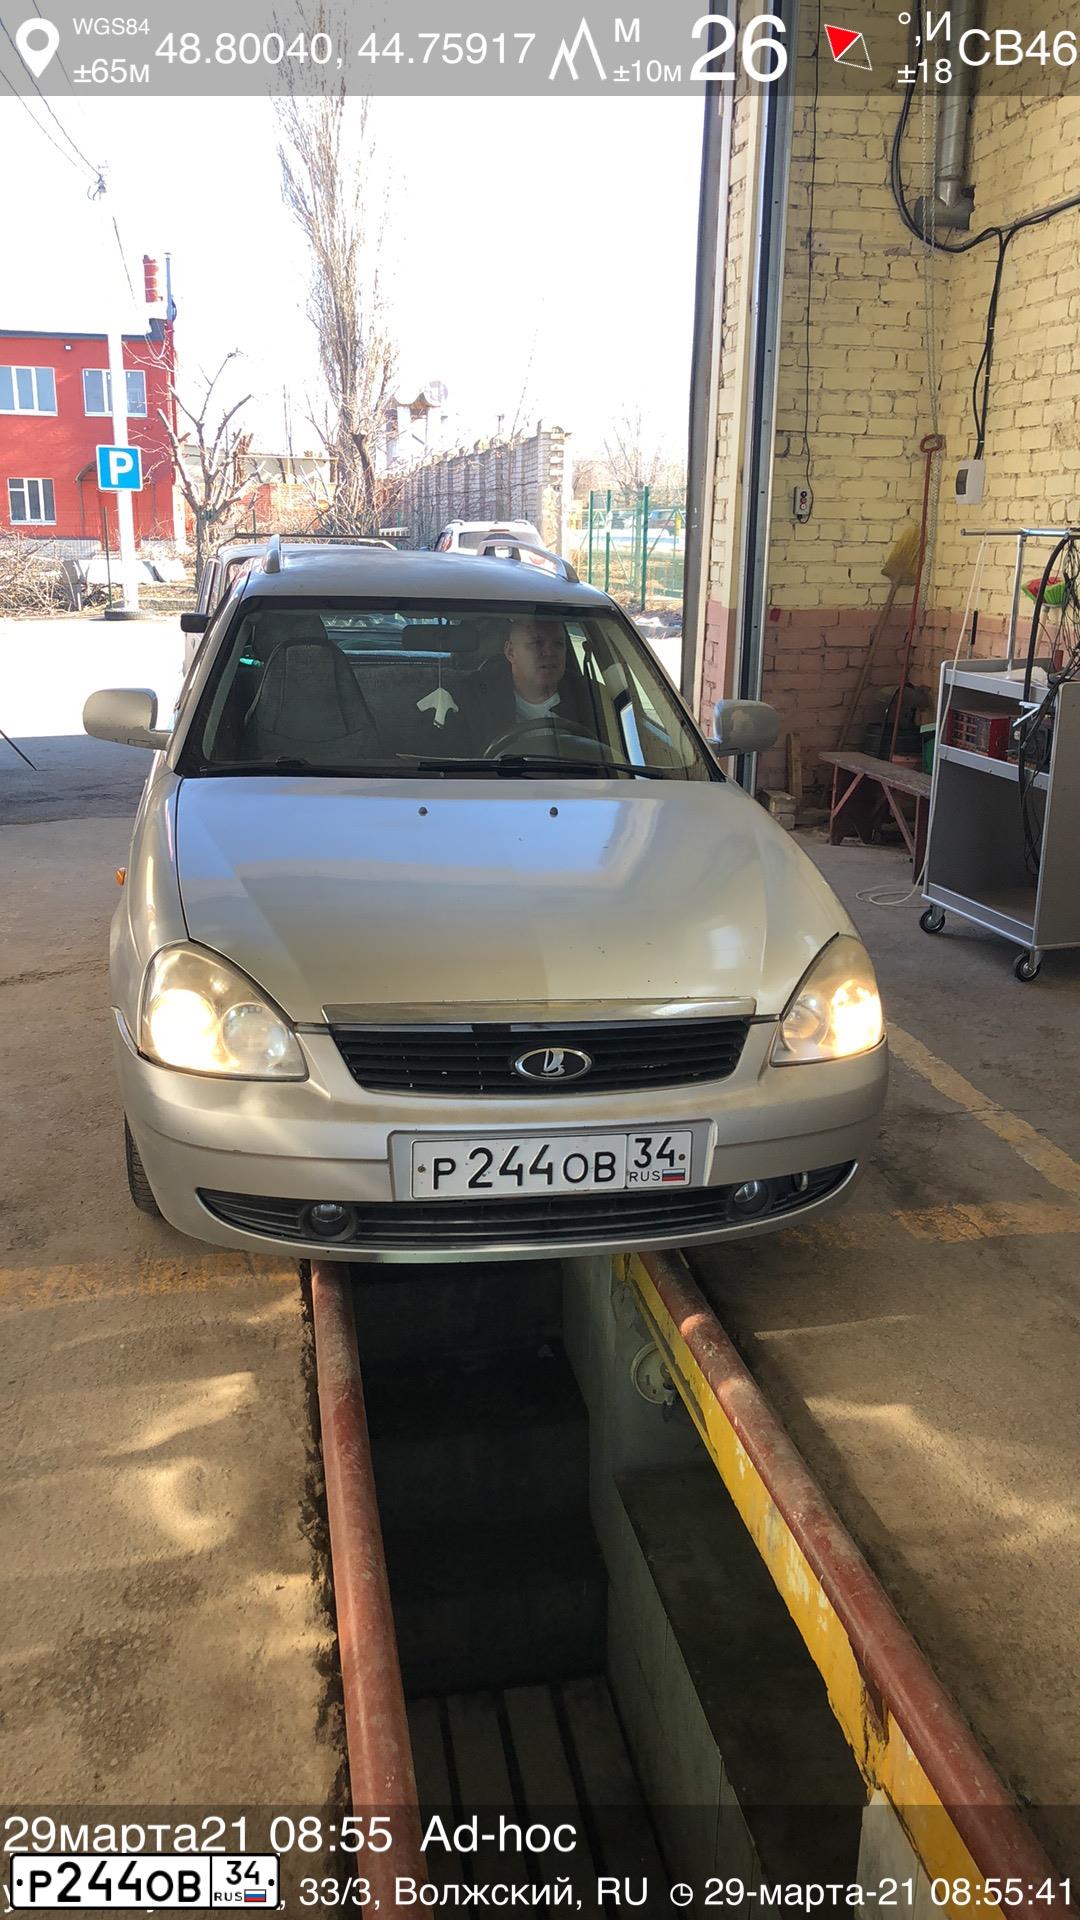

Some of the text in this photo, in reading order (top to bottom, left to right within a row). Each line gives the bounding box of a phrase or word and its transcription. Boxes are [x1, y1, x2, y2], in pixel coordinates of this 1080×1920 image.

[109, 451, 133, 485] P
[433, 1136, 675, 1189] Р244ОВ 34
[629, 1171, 660, 1182] RUS
